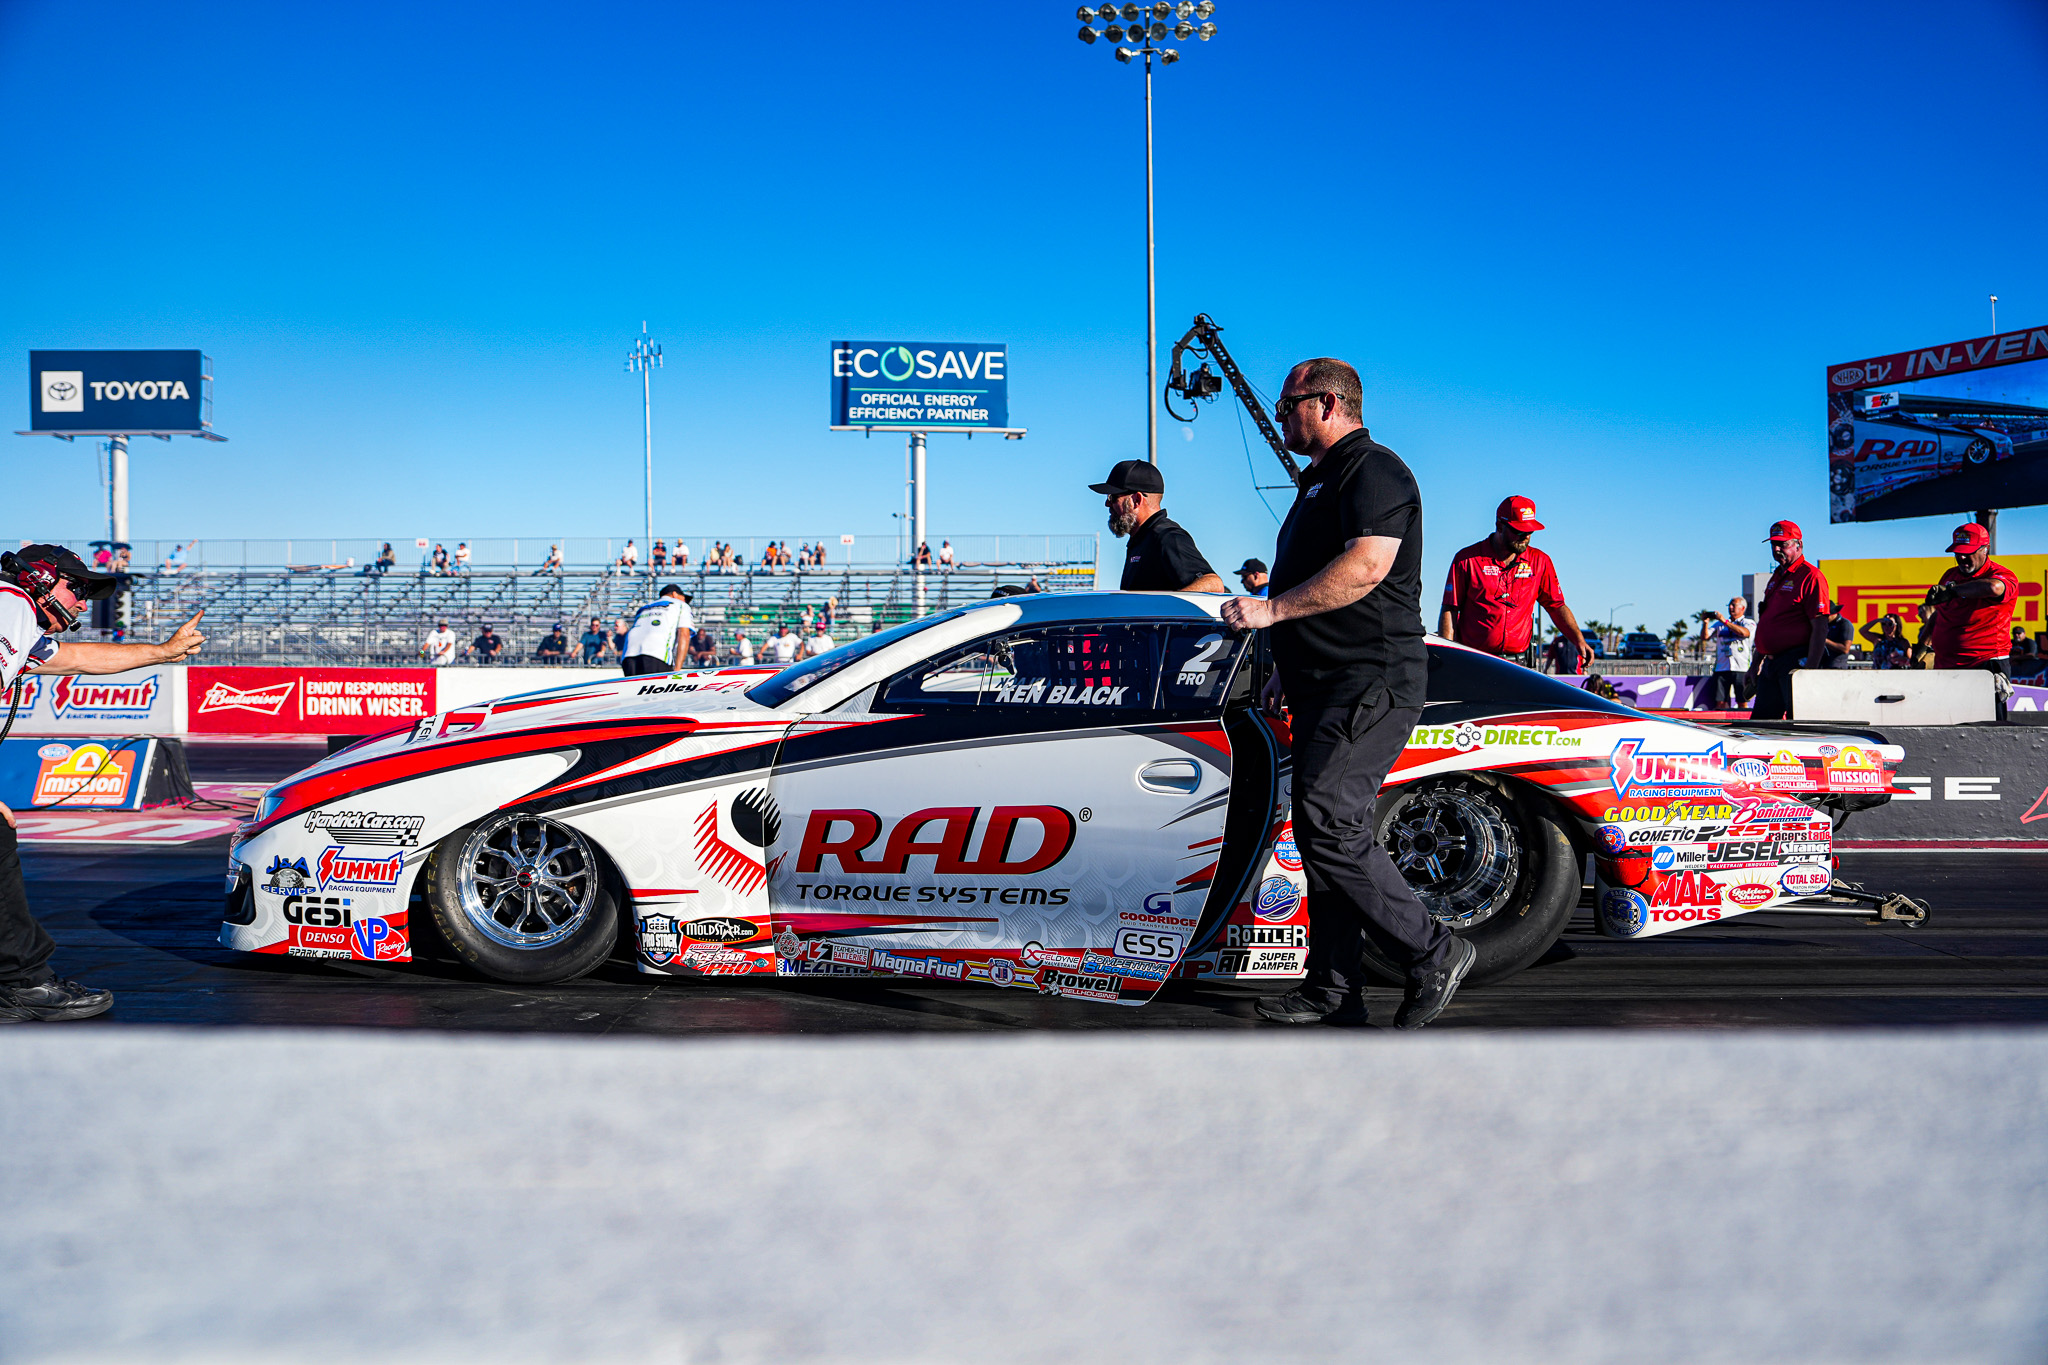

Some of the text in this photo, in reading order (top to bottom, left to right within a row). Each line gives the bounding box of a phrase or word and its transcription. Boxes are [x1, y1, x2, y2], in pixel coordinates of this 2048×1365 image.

[833, 346, 1004, 381] ECOSAVE
[90, 380, 190, 401] TOYOTA
[861, 393, 977, 407] OFFICIAL ENERGY
[849, 407, 988, 420] EFFICIENCY PARTNER
[1854, 438, 1938, 462] RAD
[1180, 633, 1224, 672] 2
[1176, 672, 1206, 686] PRO
[53, 675, 154, 712] SUMMIT
[306, 681, 428, 696] ENJOY RESPONSIBLY.
[637, 683, 699, 696] Holley
[995, 684, 1130, 705] KEN BLACK
[206, 688, 286, 706] Budweiser
[306, 697, 428, 717] DRINK WISER.
[1613, 743, 1722, 790] SUMMIT
[1735, 763, 1769, 778] NHRA
[1770, 765, 1804, 774] MISSION
[44, 777, 122, 793] MISSION
[1775, 781, 1815, 789] CHALLENGE
[1830, 771, 1879, 784] MISSION
[1628, 788, 1723, 797] RACING EQUIPMENT
[1628, 826, 1695, 842] COMETIC
[1768, 831, 1808, 841] racers
[1708, 842, 1781, 863] JESEL
[1780, 841, 1830, 854] Strange
[1676, 852, 1707, 863] Miller
[266, 854, 311, 878] J&A
[318, 848, 401, 886] SUMMIT
[1785, 873, 1828, 885] TOTAL SEAL
[261, 884, 316, 896] SERVICE
[328, 884, 396, 894] RACING EQUIPMENT
[796, 884, 1071, 906] TORQUE SYSTEMS
[1731, 887, 1772, 897] Golden
[1734, 893, 1768, 901] Shine
[1119, 911, 1197, 927] GOODRIDGE
[1650, 907, 1721, 922] TOOLS
[1138, 922, 1170, 930] TRANSFER
[305, 931, 345, 944] DENSO
[353, 917, 389, 959] VP
[641, 933, 678, 949] PRO STOCK
[1227, 925, 1307, 946] ROTTLER
[376, 941, 405, 956] Racing
[833, 945, 868, 956] FEATHER-LITE
[1122, 932, 1175, 958] ESS
[289, 948, 352, 960] SPARK PLUGS
[682, 952, 747, 962] RACE STAR
[833, 952, 868, 962] BATTERIES
[1259, 952, 1296, 961] SUPER
[871, 950, 965, 978] MagnaFuel
[1044, 960, 1077, 969] VALVETRAIN
[1084, 953, 1170, 972] COMPETITIVE
[1252, 961, 1299, 971] DAMPER
[1084, 962, 1165, 981] SUSPENSION
[1042, 969, 1122, 993] Browell
[1062, 987, 1117, 1001] BELLHOUSING
